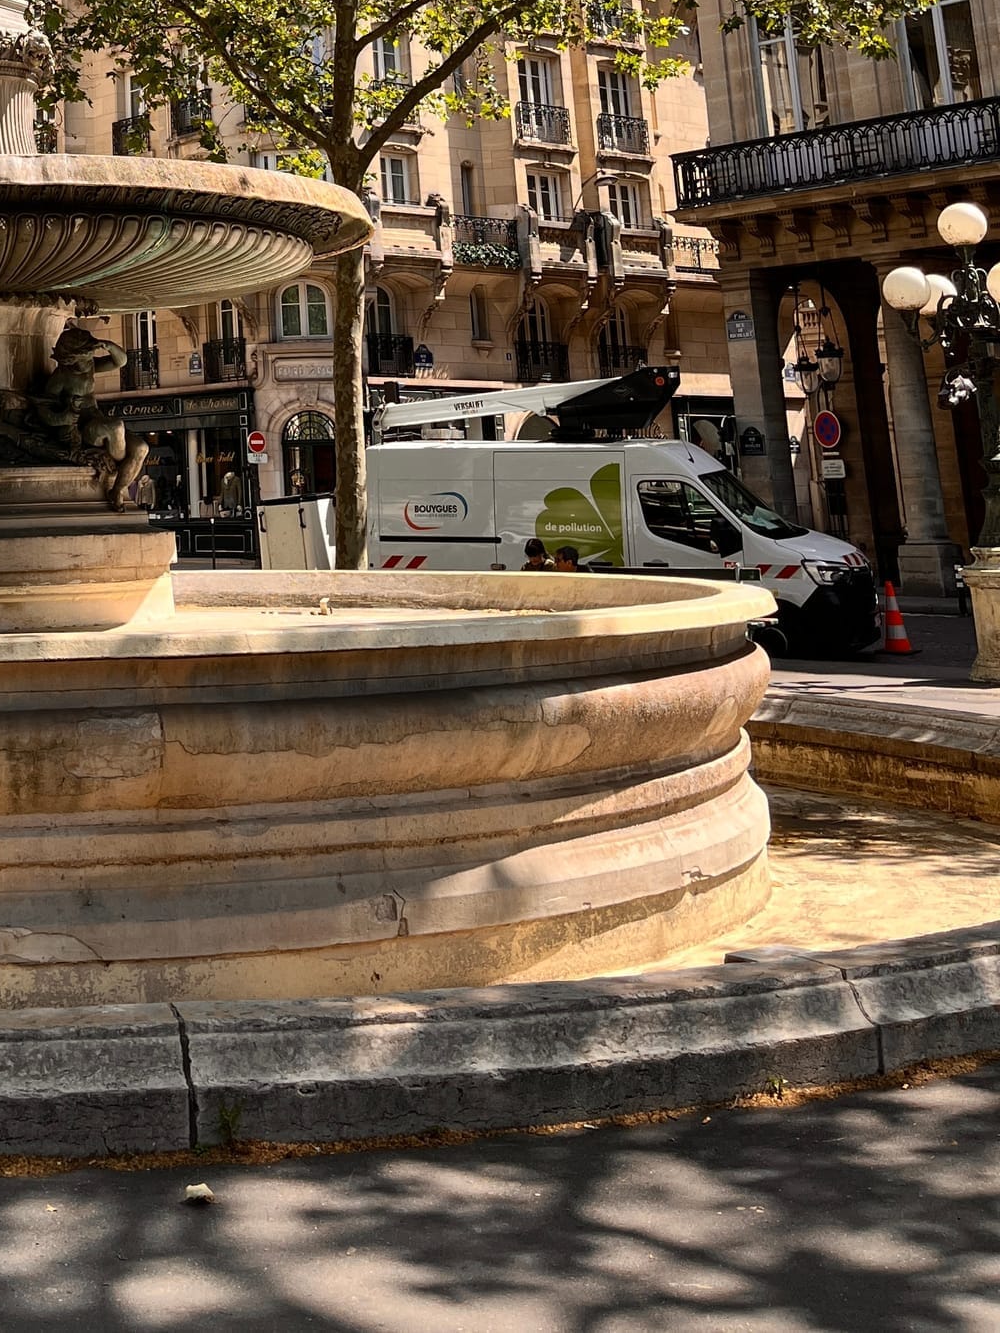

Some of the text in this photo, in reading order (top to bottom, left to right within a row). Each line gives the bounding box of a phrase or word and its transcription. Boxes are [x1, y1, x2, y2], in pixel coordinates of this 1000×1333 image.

[414, 505, 458, 513] BOUYGUES
[544, 521, 602, 534] de pollution
